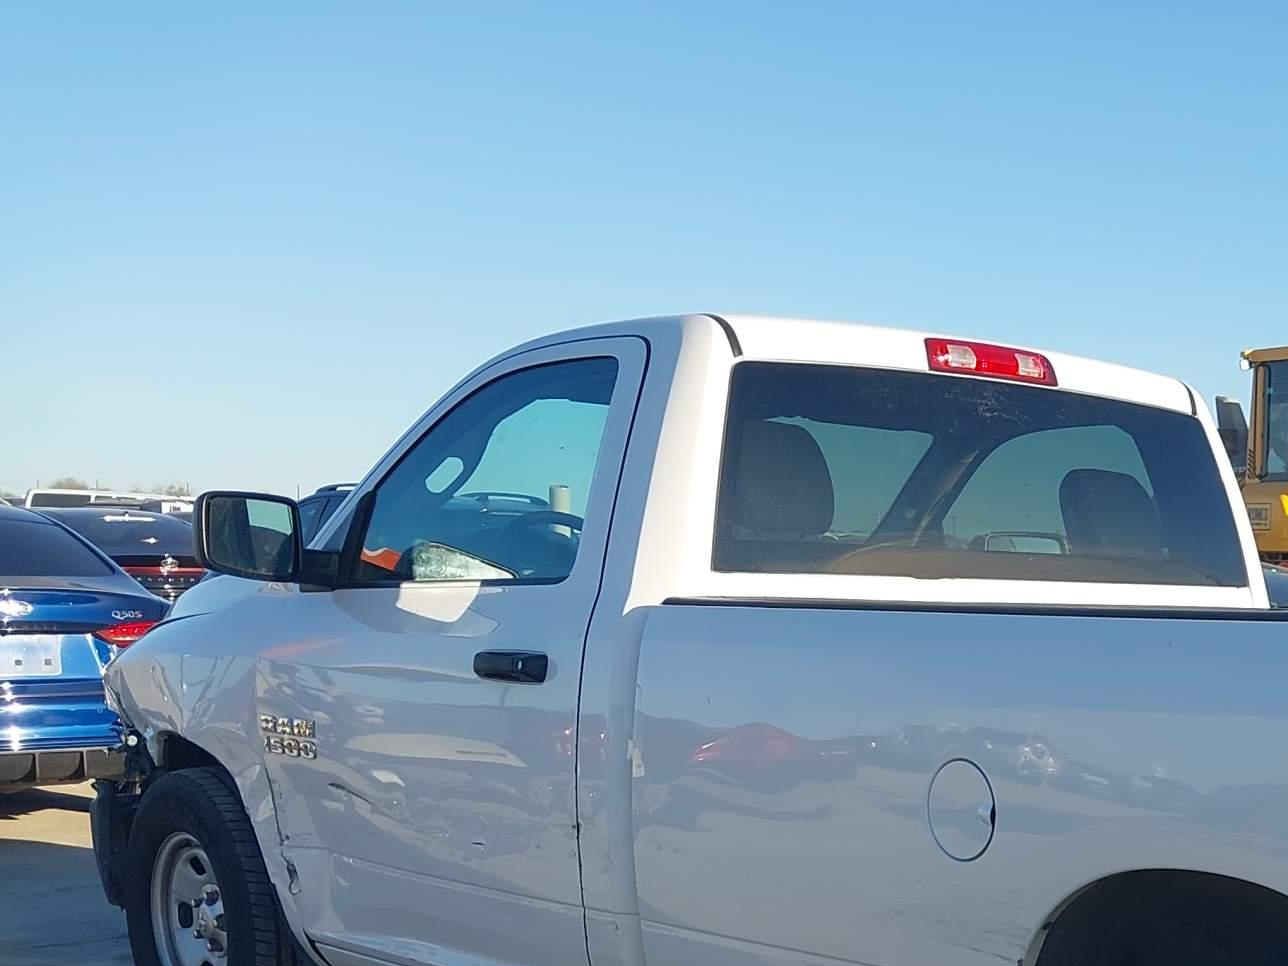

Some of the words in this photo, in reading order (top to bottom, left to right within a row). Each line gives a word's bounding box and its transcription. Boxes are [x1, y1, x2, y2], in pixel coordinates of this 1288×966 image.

[111, 609, 144, 621] Q50S
[259, 714, 316, 738] RAM
[263, 735, 318, 760] 1500
